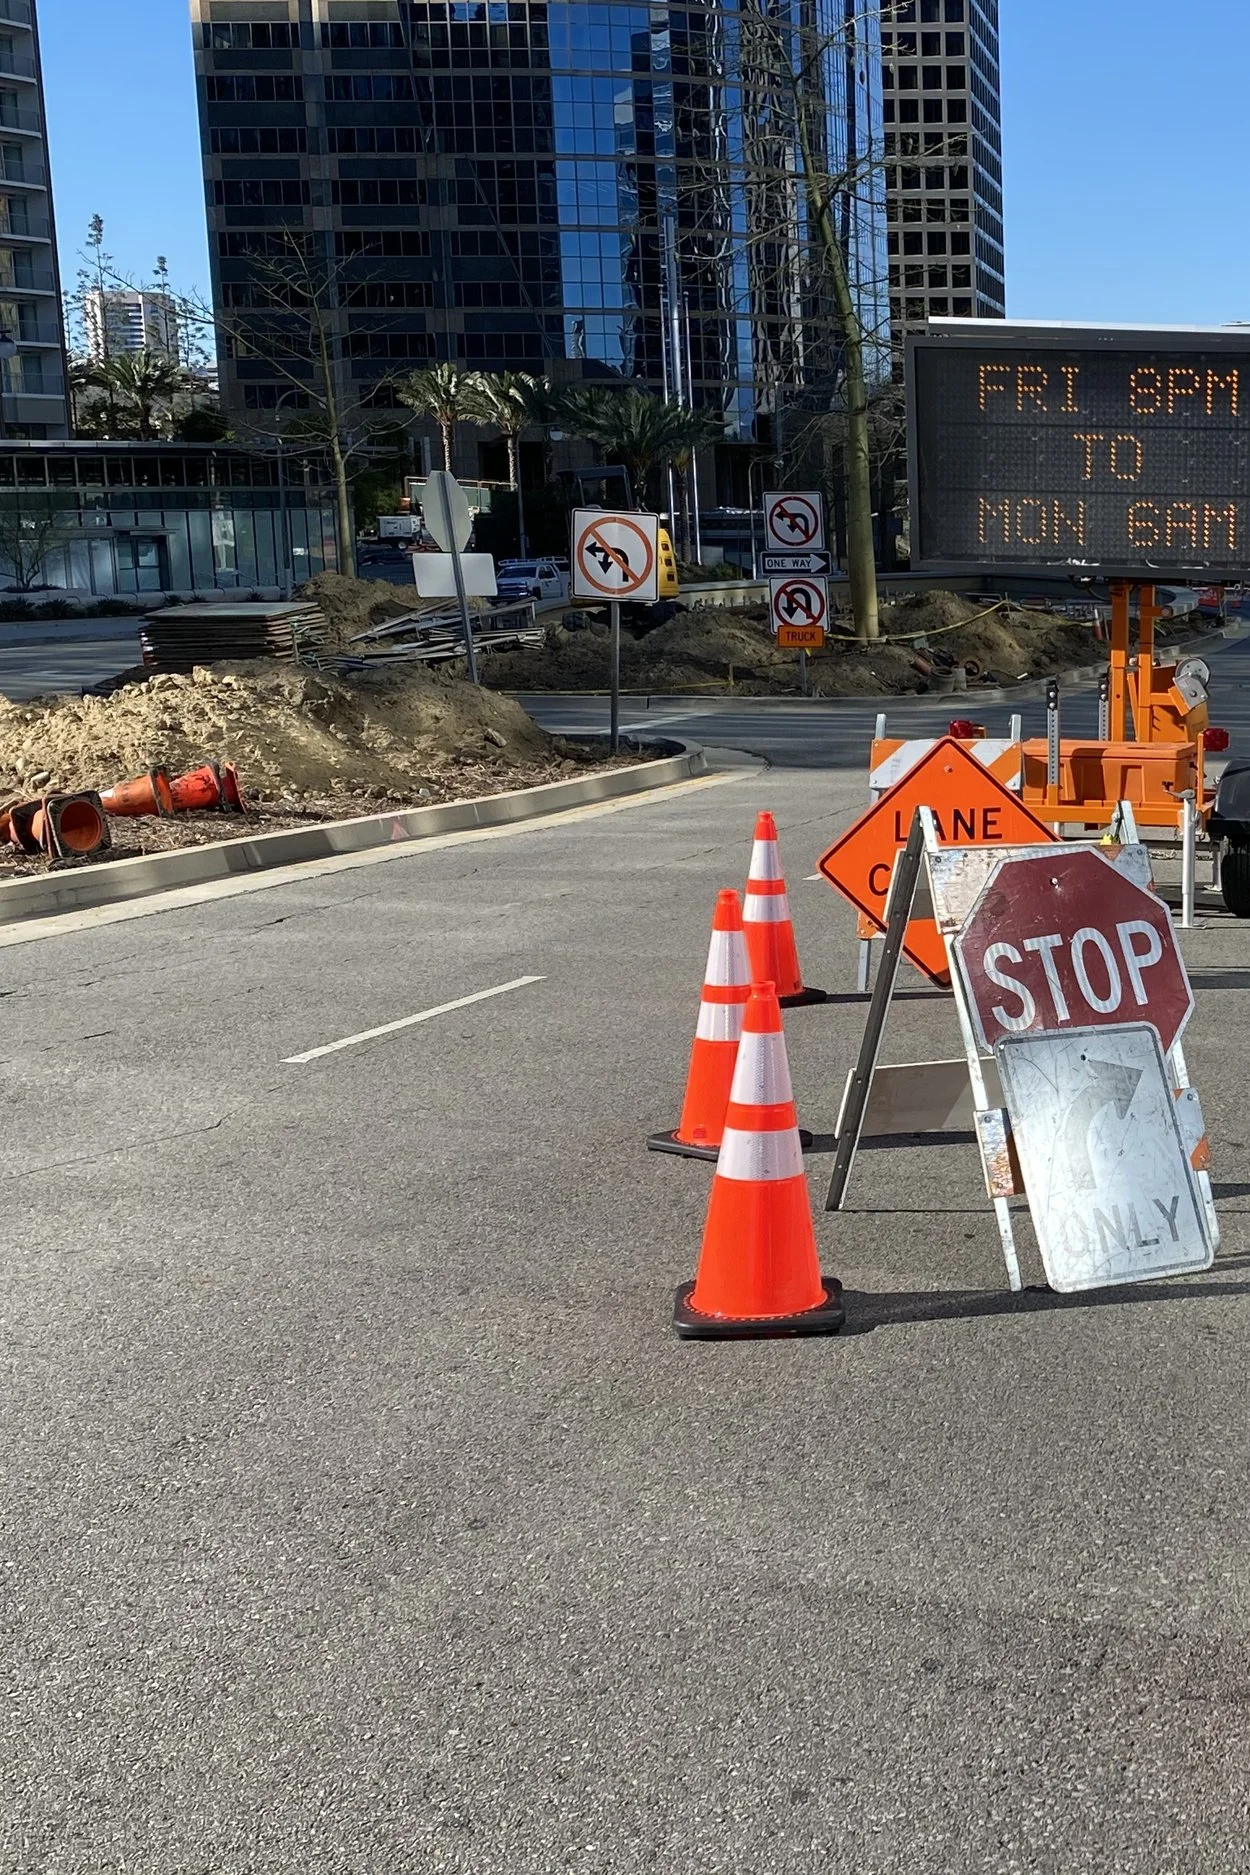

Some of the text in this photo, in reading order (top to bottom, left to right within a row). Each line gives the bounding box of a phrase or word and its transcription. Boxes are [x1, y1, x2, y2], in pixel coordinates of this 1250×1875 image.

[978, 364, 1239, 416] FRI 8PM
[1072, 433, 1143, 480] TO
[978, 498, 1237, 549] MON 6AM
[766, 559, 812, 568] ONE WAY
[785, 631, 816, 642] TRUCK
[983, 919, 1163, 1032] STOP
[1063, 1195, 1180, 1258] ONLY
